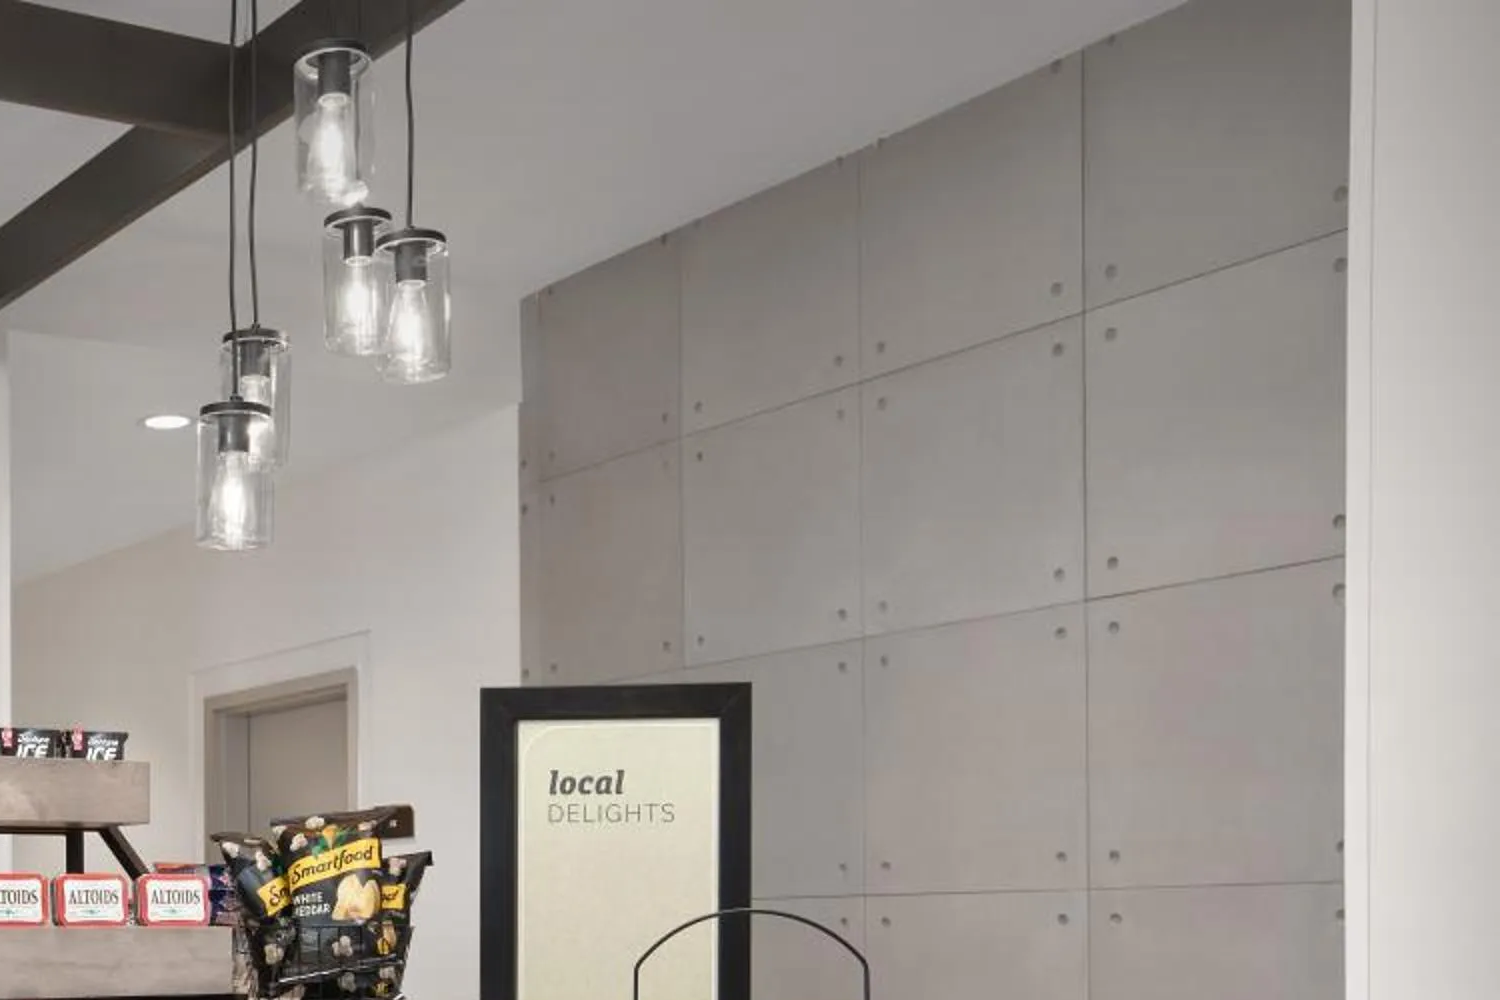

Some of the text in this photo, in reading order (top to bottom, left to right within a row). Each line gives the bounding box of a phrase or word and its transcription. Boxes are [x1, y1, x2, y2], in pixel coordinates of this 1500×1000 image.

[548, 769, 625, 796] local
[548, 803, 676, 824] DELIGHTS
[291, 846, 373, 886] Smartfood
[69, 889, 119, 906] ALTOIDS
[151, 889, 201, 906] ALTOIDS
[295, 903, 331, 917] EDDAR
